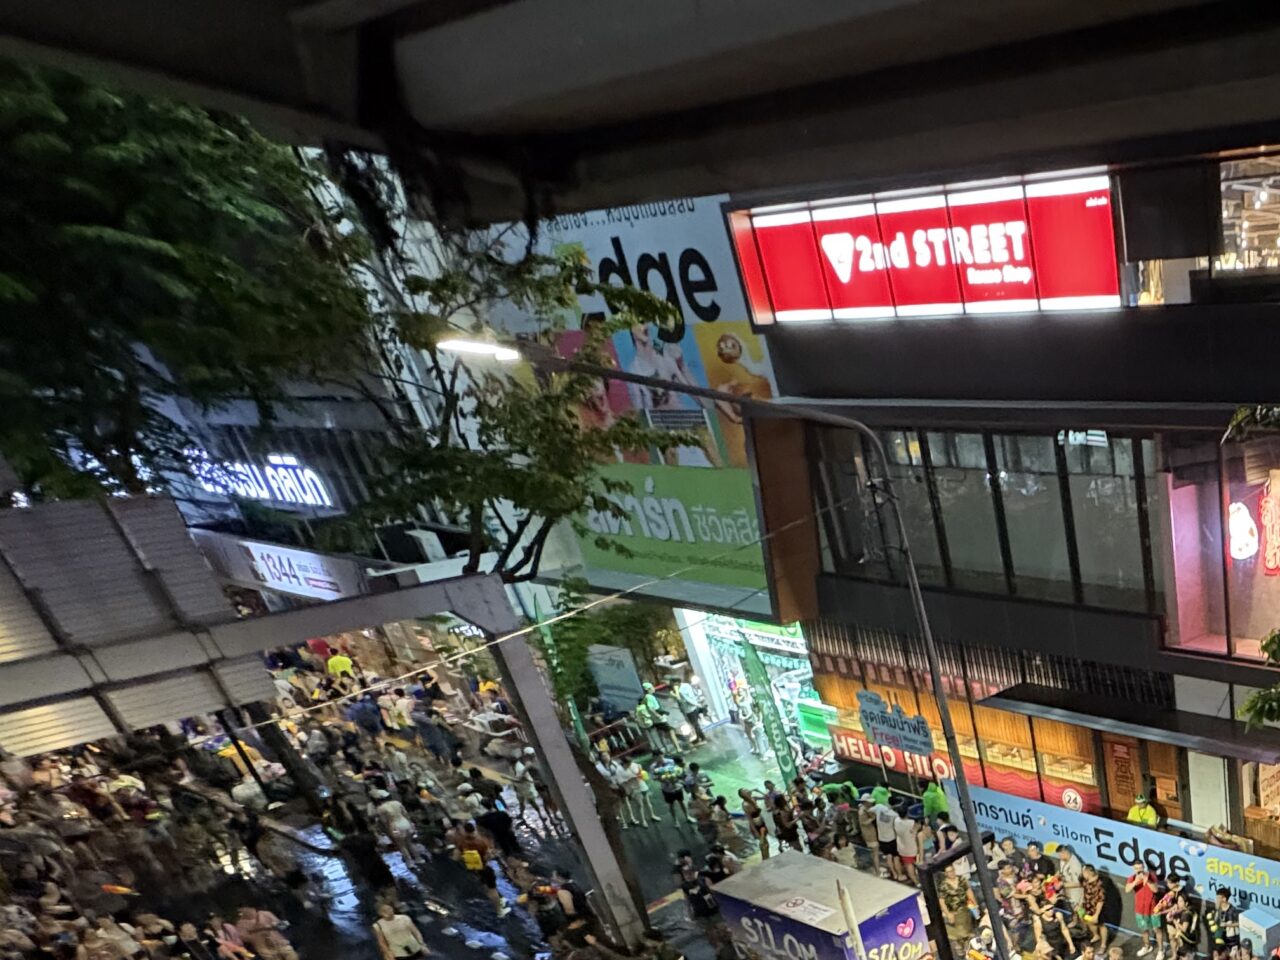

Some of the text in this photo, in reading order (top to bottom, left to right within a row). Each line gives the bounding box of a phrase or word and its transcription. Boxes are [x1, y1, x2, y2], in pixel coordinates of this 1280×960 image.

[855, 220, 1027, 272] 2nd STREET
[260, 552, 303, 587] 1344
[832, 733, 896, 768] HELLO
[871, 726, 901, 746] Free
[1052, 822, 1191, 882] Silom Edge
